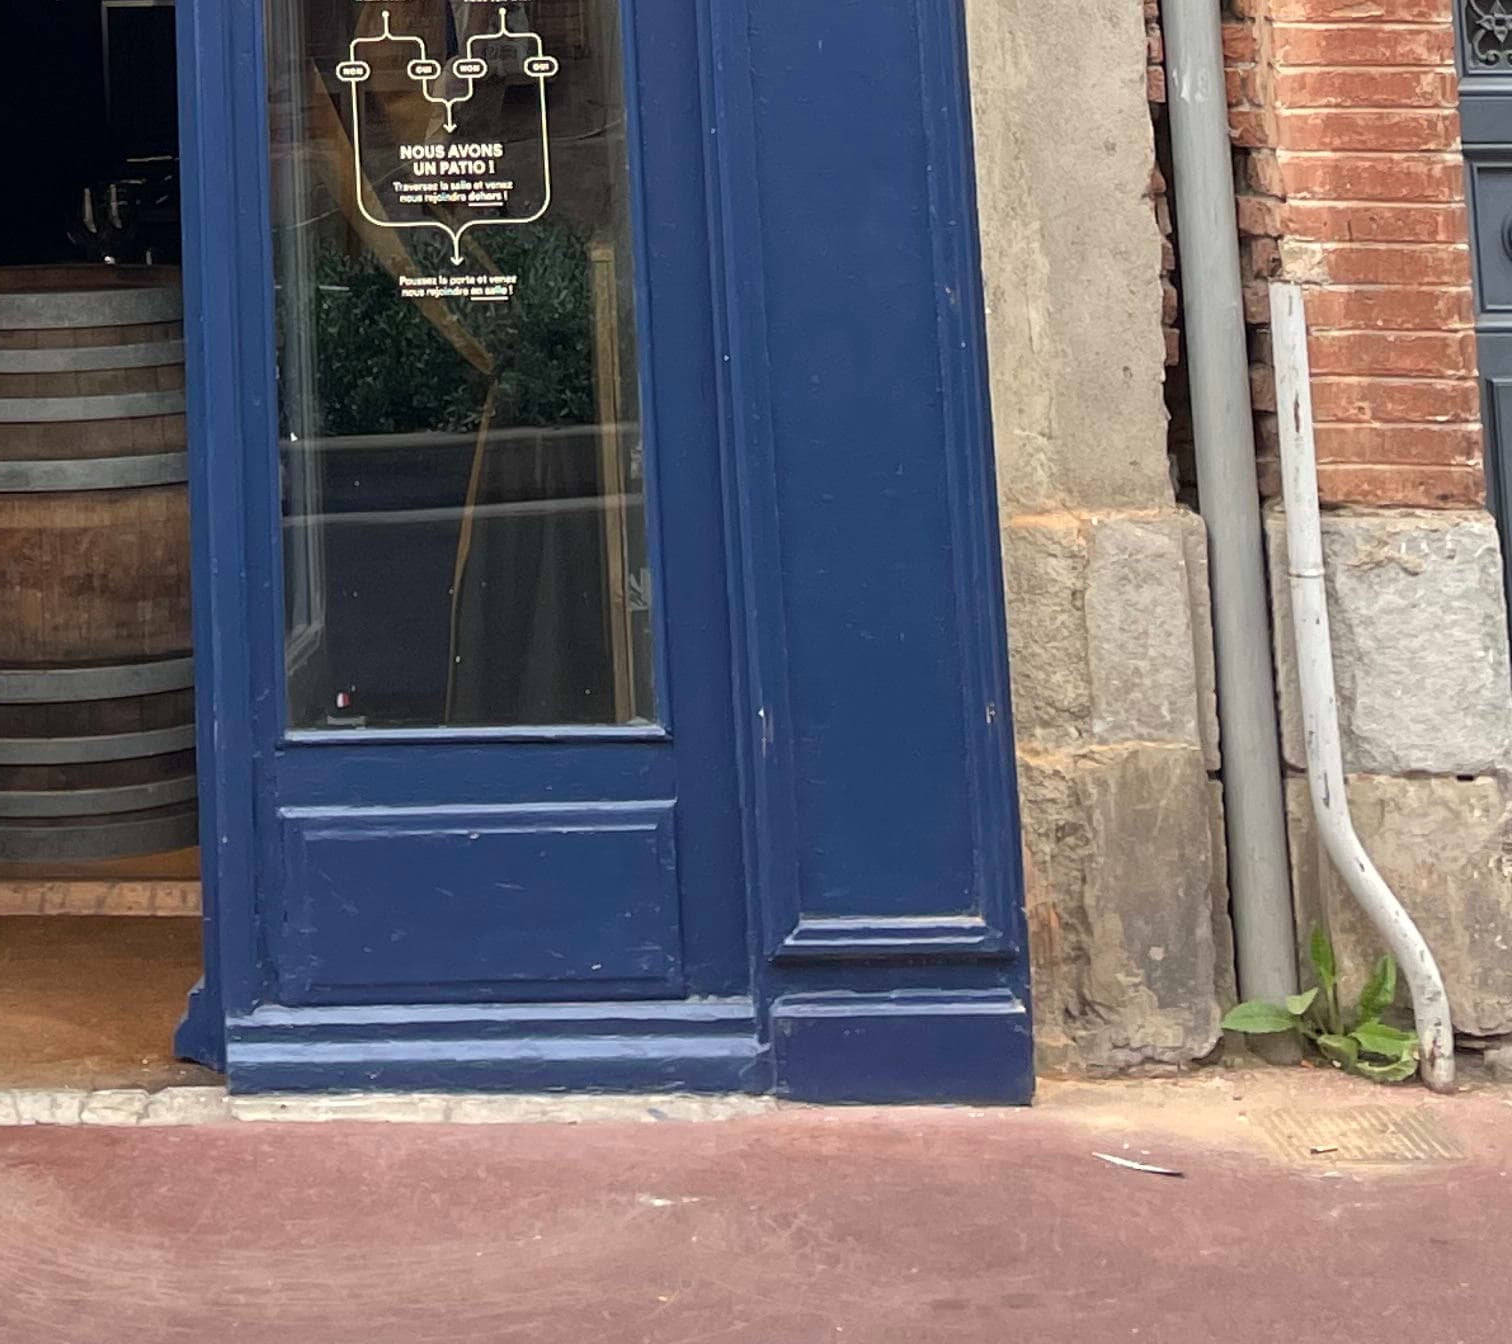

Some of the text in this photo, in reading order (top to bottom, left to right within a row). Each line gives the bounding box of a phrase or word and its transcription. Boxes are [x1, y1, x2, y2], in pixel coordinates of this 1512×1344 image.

[399, 143, 503, 160] NOUS AVONS
[413, 161, 437, 176] UN
[439, 160, 486, 175] PATIO
[399, 194, 423, 204] nous
[424, 192, 467, 204] rejoindre
[467, 191, 502, 202] dehors
[400, 288, 425, 298] nous
[426, 286, 469, 299] rejoindre
